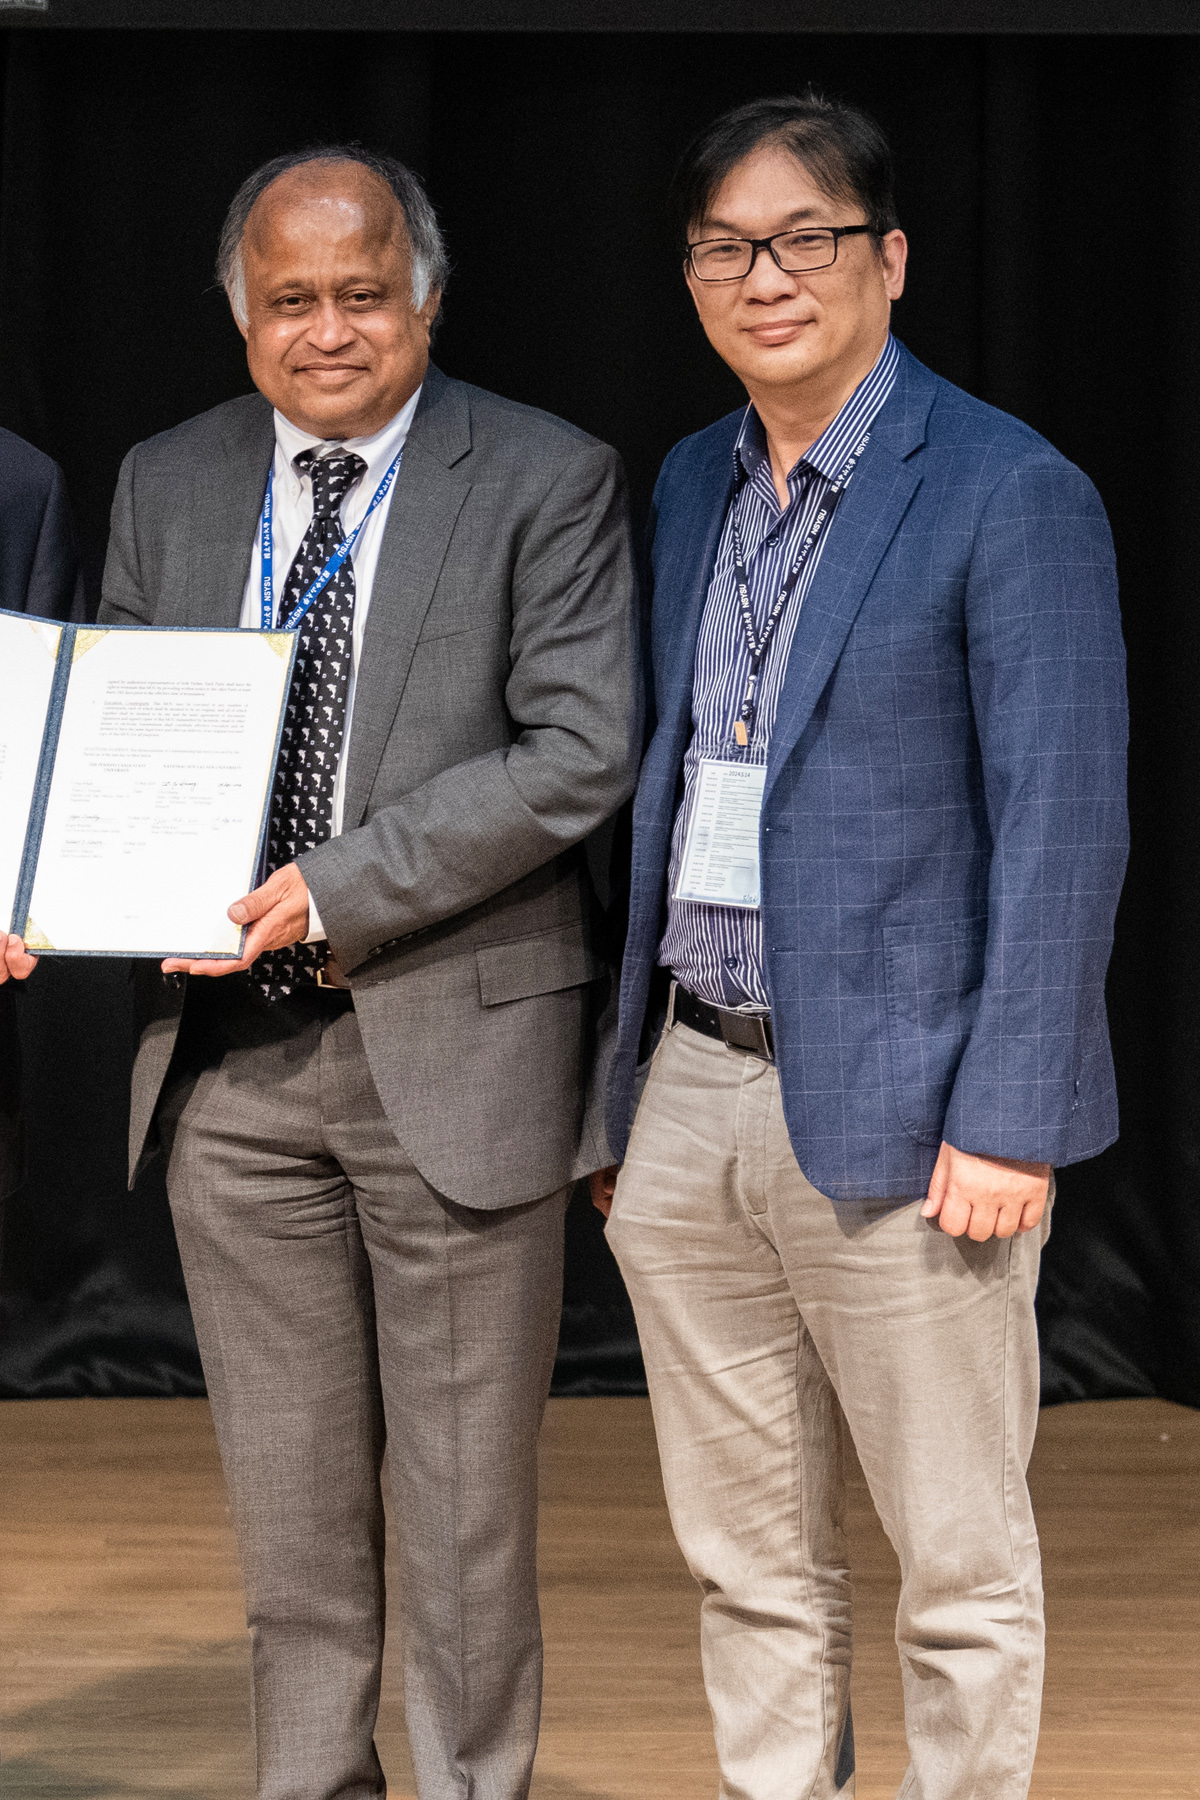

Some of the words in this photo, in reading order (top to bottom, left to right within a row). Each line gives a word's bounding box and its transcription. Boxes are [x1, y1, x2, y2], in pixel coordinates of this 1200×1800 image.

[811, 508, 827, 536] NSYSU
[337, 533, 356, 558] NSYSU
[739, 584, 749, 609] NSYSU
[772, 590, 788, 617] NSYSU
